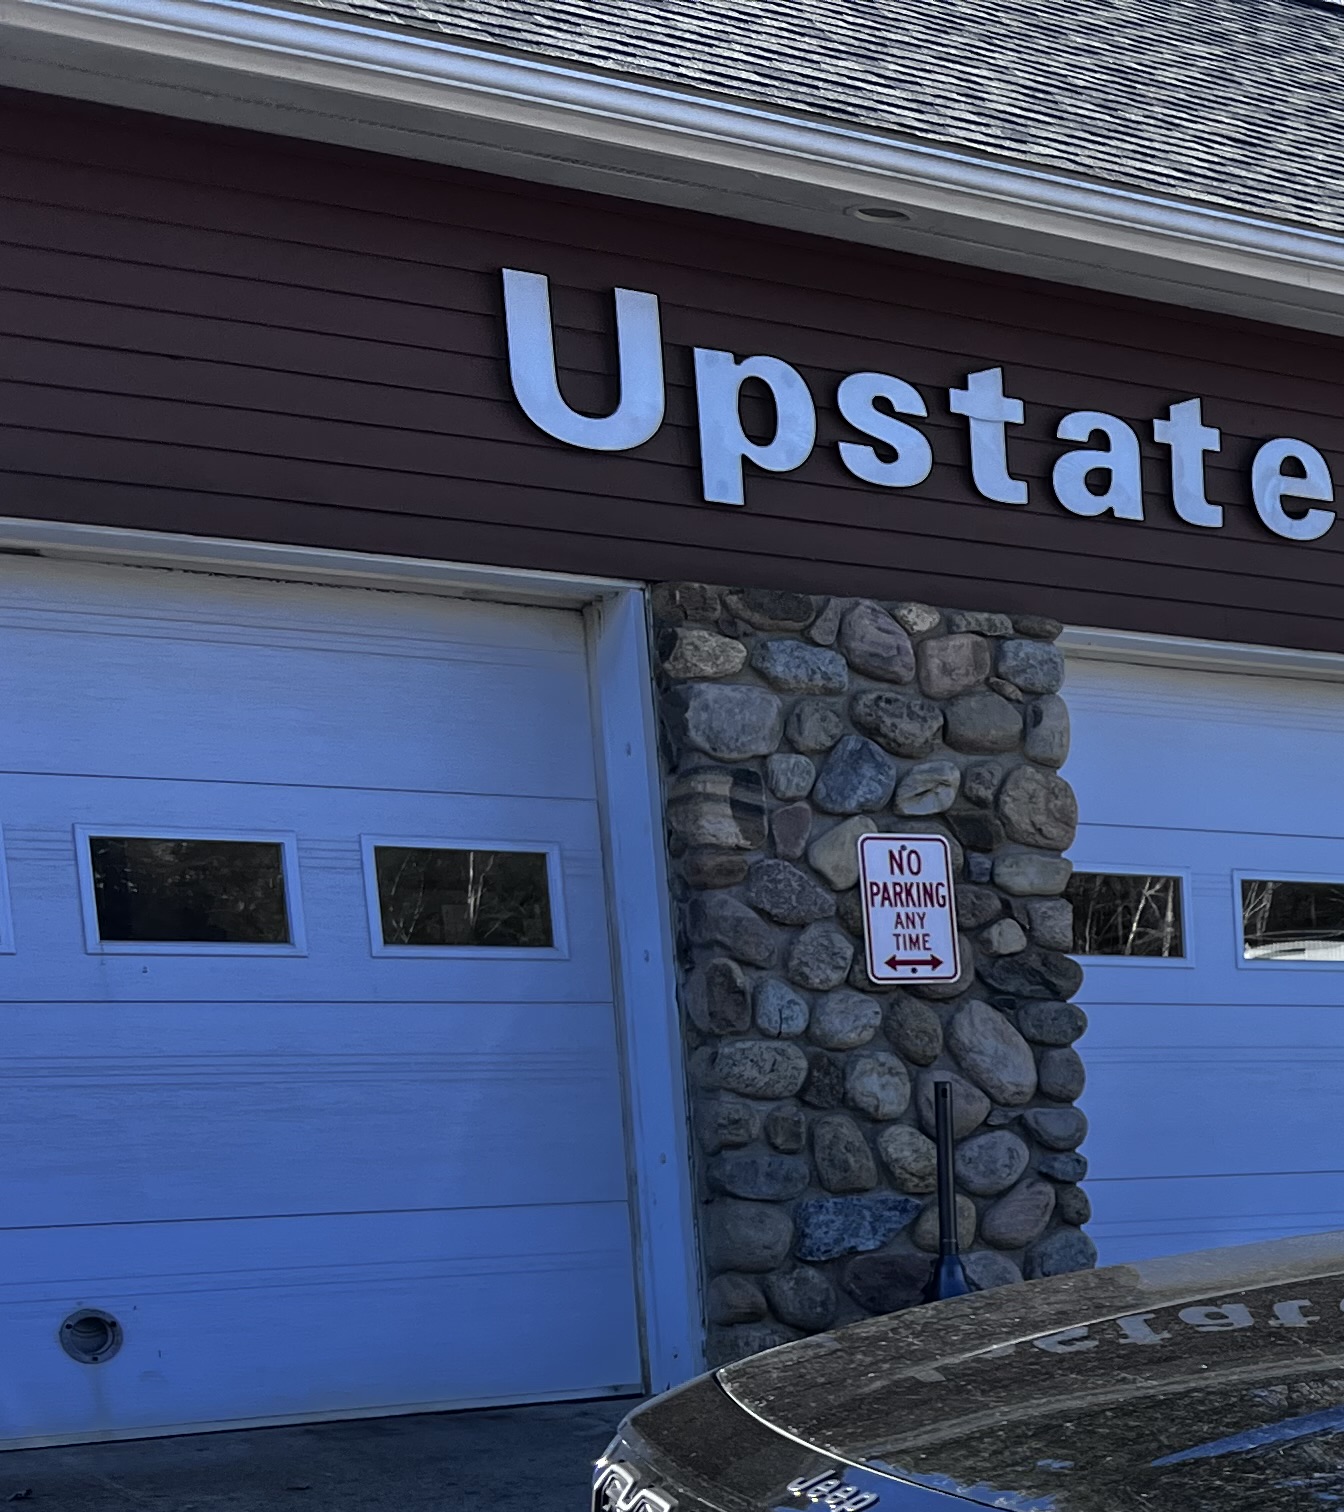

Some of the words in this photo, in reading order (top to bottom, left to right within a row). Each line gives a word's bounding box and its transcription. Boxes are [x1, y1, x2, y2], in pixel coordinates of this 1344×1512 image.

[501, 267, 1337, 541] Upstate
[888, 849, 922, 876] NO
[869, 881, 947, 908] PARKING
[894, 912, 926, 930] ANY
[893, 933, 932, 951] TIME
